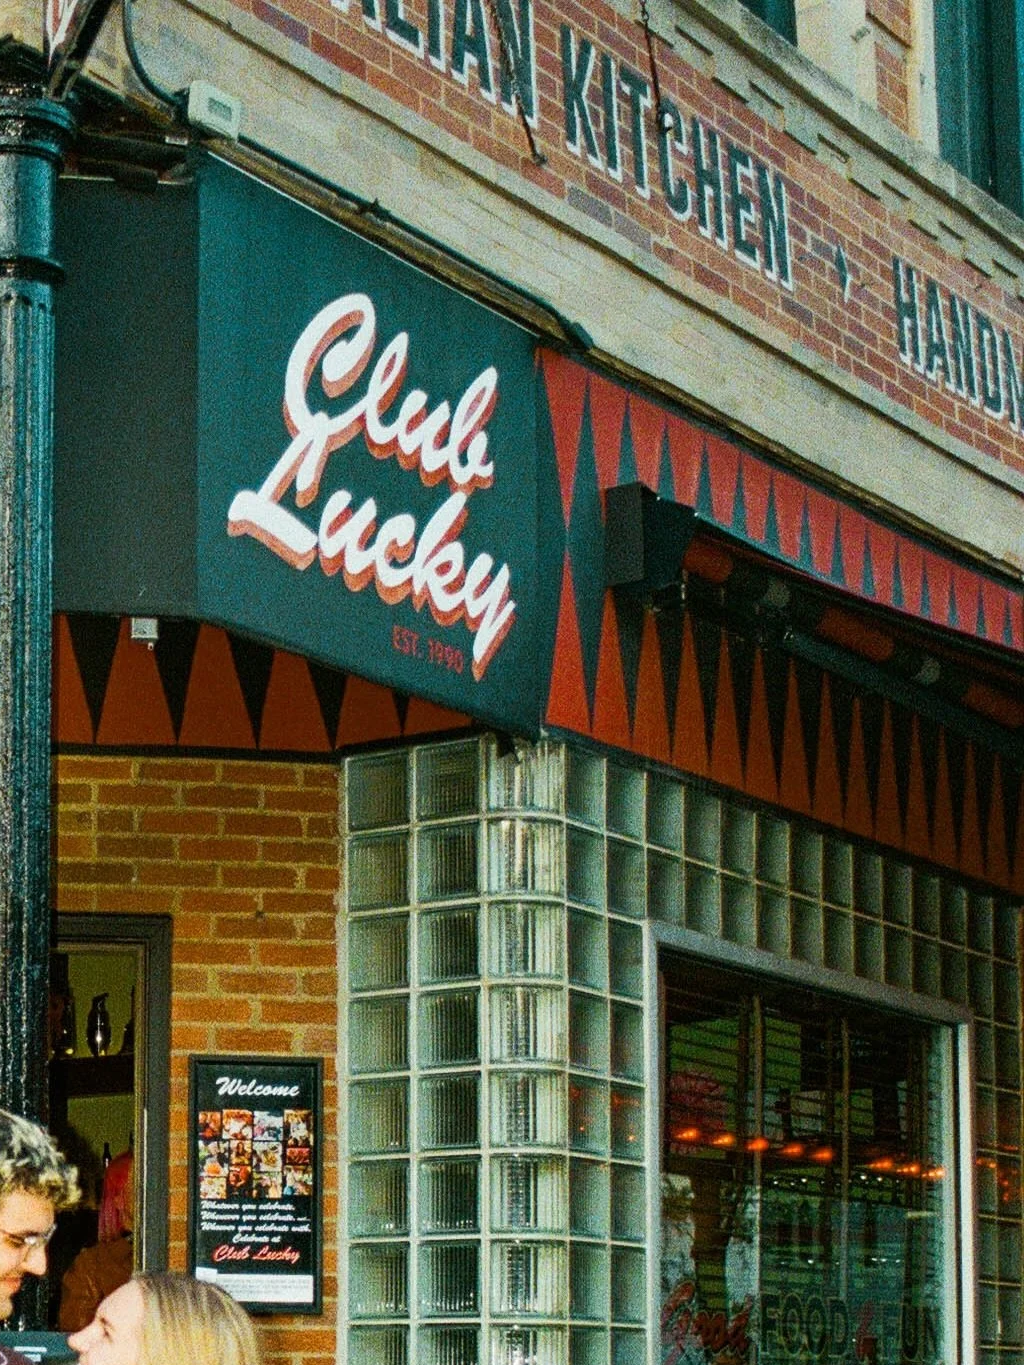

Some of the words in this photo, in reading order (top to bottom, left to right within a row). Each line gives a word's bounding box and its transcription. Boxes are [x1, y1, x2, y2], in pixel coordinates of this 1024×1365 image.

[560, 24, 794, 292] KITCHEN
[283, 293, 498, 493] Club
[227, 413, 516, 681] Lucky
[216, 1076, 300, 1097] Welcome
[214, 1245, 250, 1261] Club
[252, 1245, 300, 1264] Lucky
